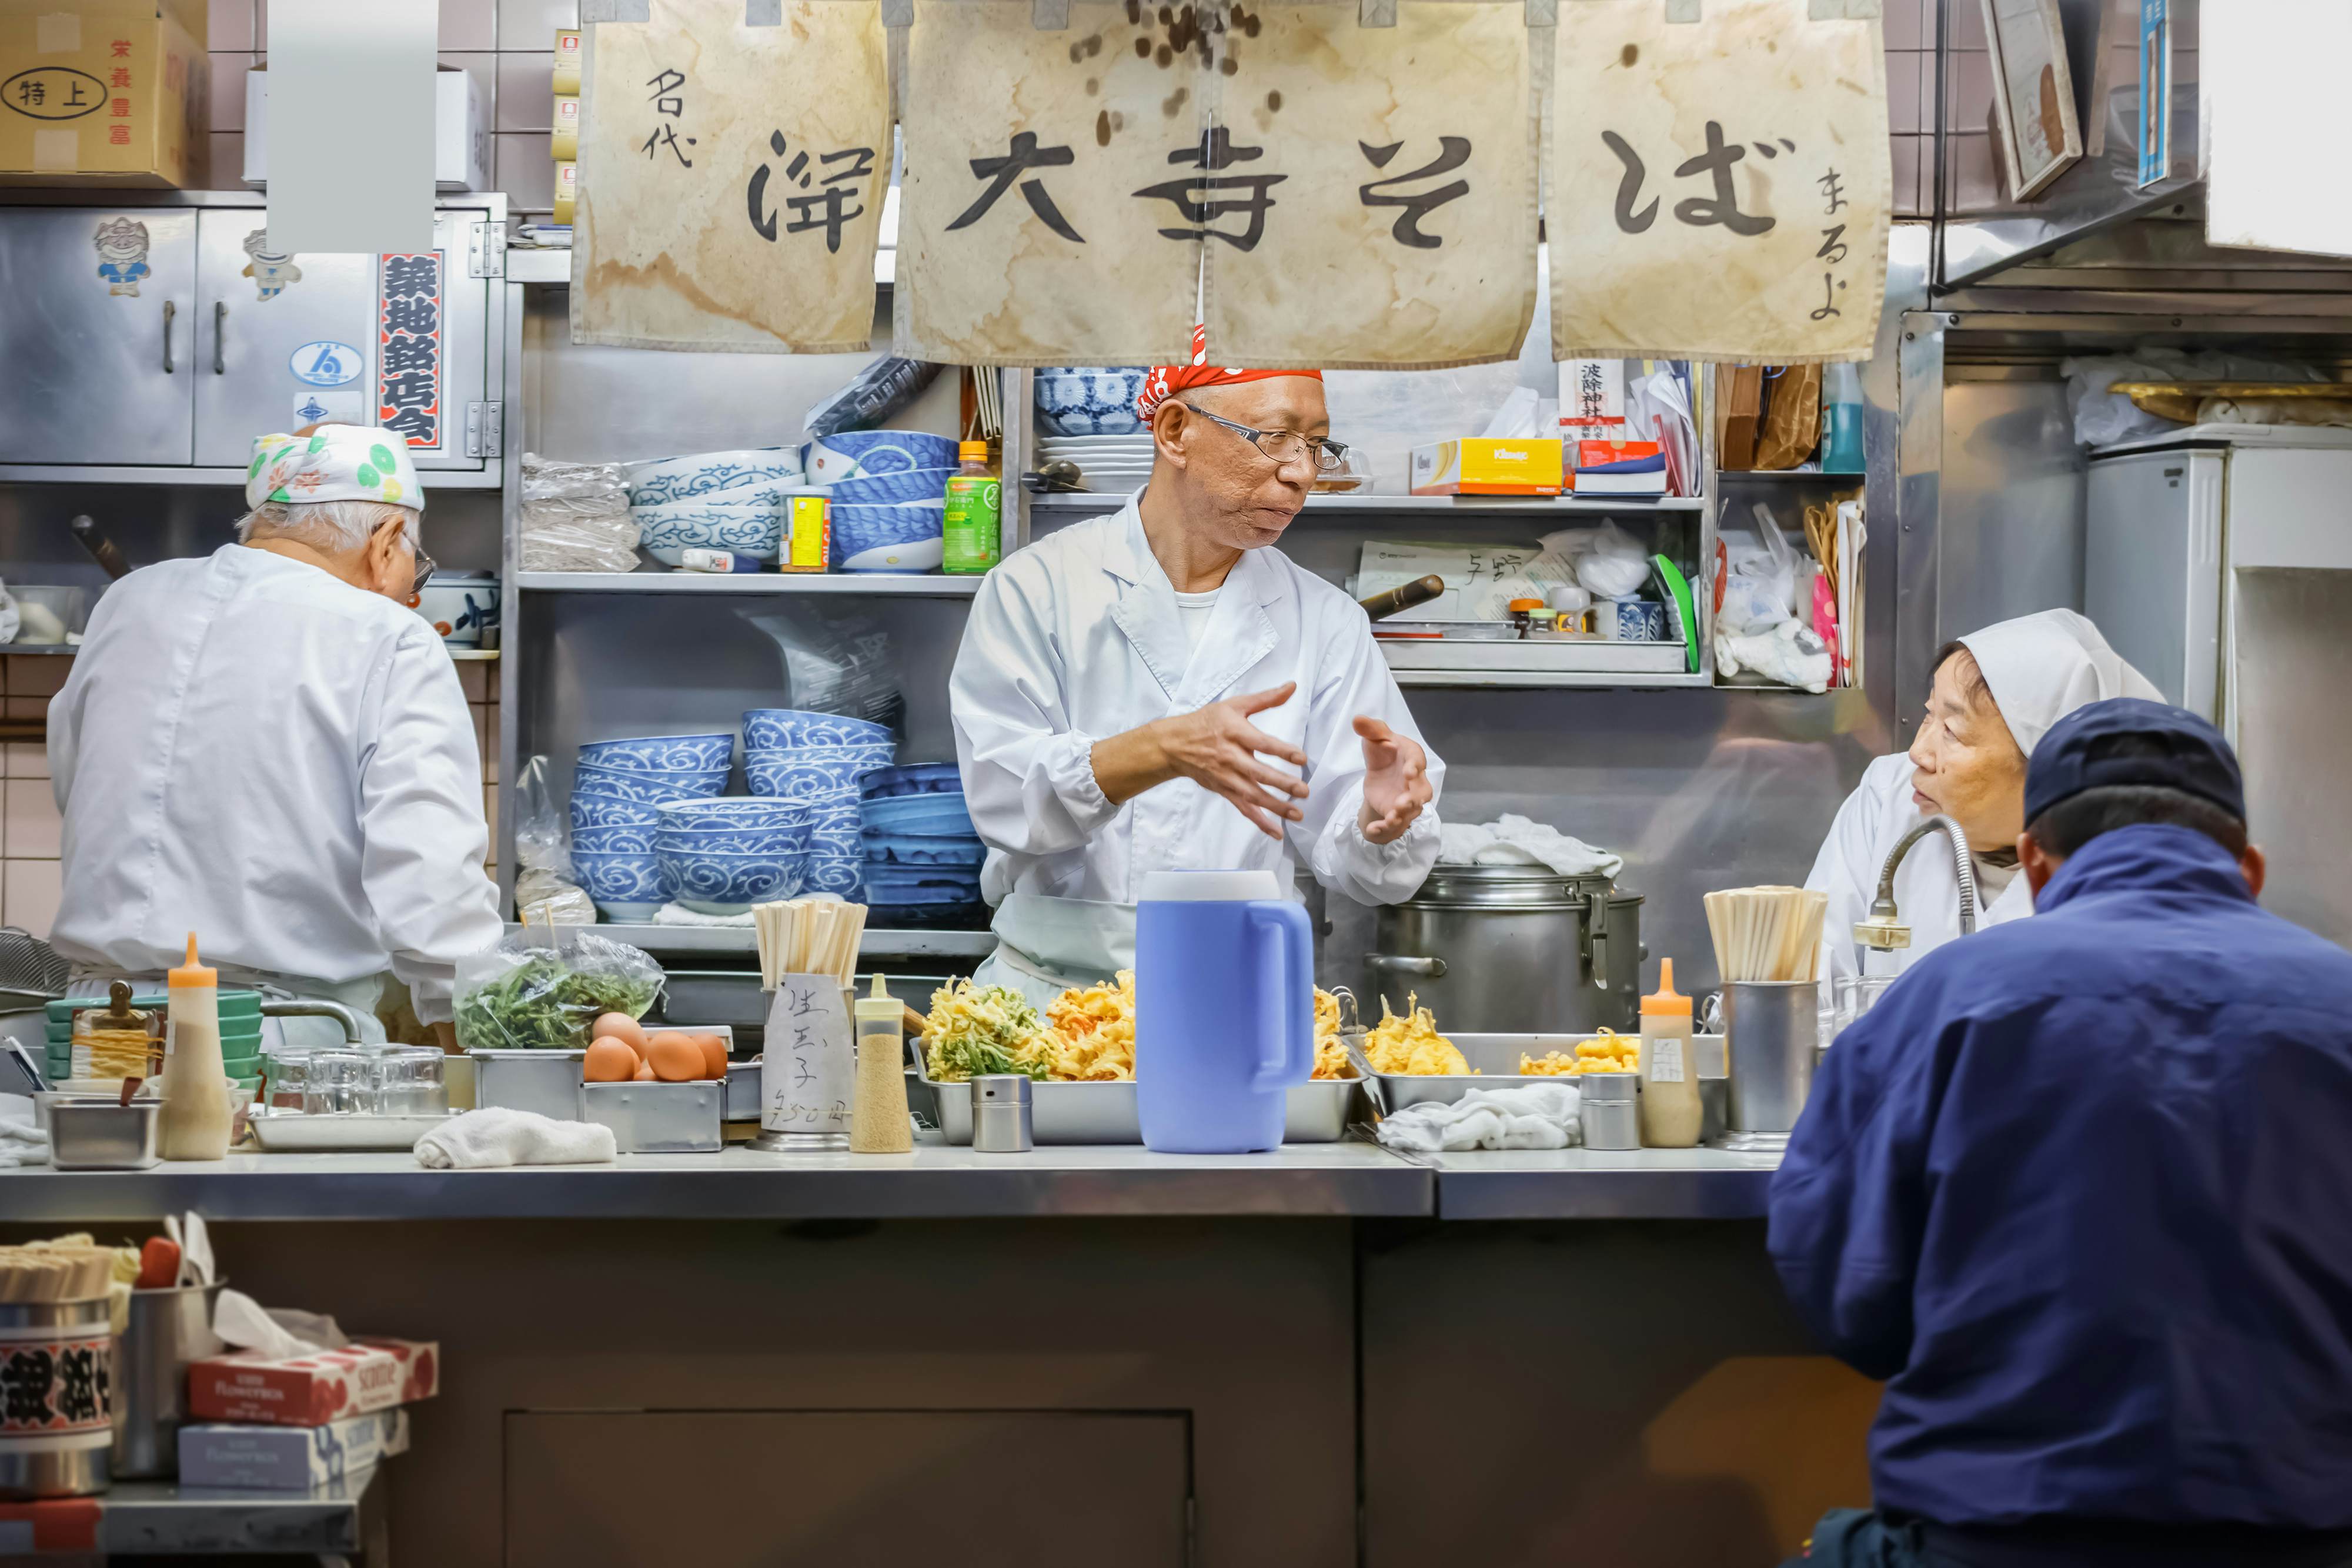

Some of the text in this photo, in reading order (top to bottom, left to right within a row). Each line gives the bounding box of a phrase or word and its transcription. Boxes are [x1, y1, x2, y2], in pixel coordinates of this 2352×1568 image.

[19, 80, 87, 106] 特上
[110, 39, 132, 145] 栄養豊富
[641, 68, 697, 168] 名代
[1810, 167, 1848, 320] まるよ
[1581, 363, 1603, 419] 波除神社
